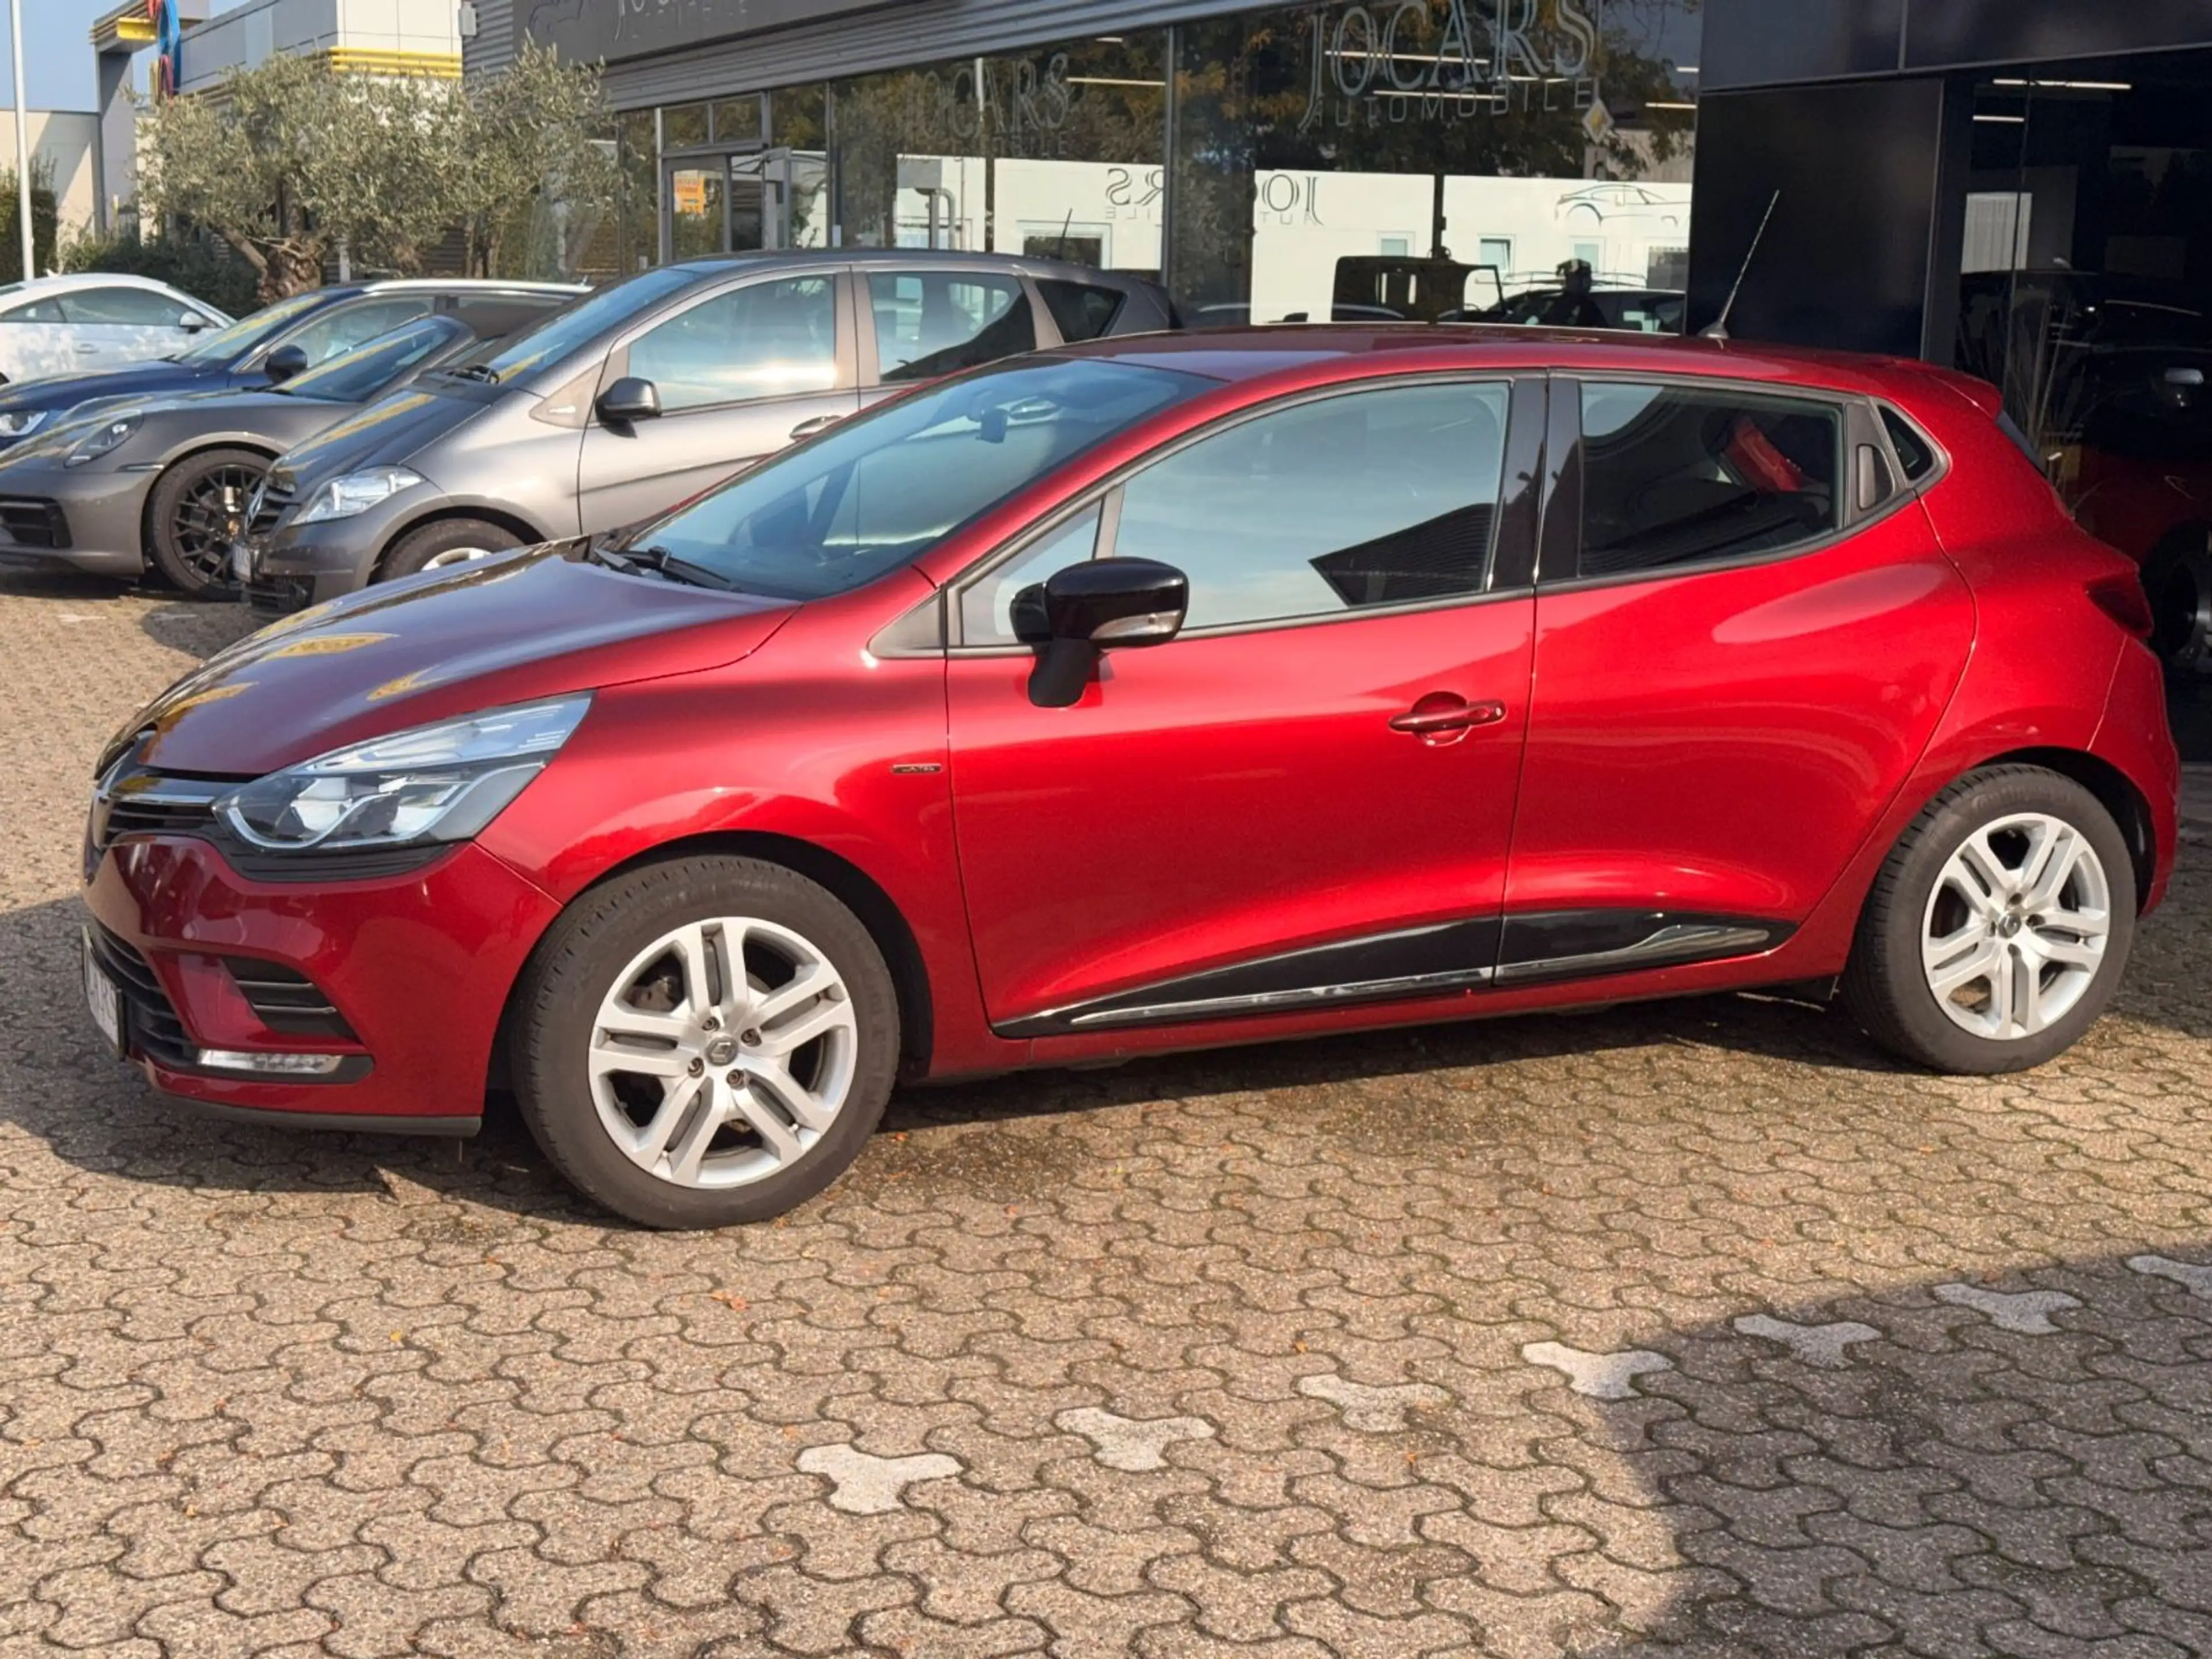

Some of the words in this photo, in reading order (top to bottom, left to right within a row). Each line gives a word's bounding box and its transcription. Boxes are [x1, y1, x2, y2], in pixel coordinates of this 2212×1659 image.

[906, 53, 1069, 140] OCARS
[1297, 0, 1594, 132] JOCARS
[1310, 78, 1592, 127] AUTOMOBILE
